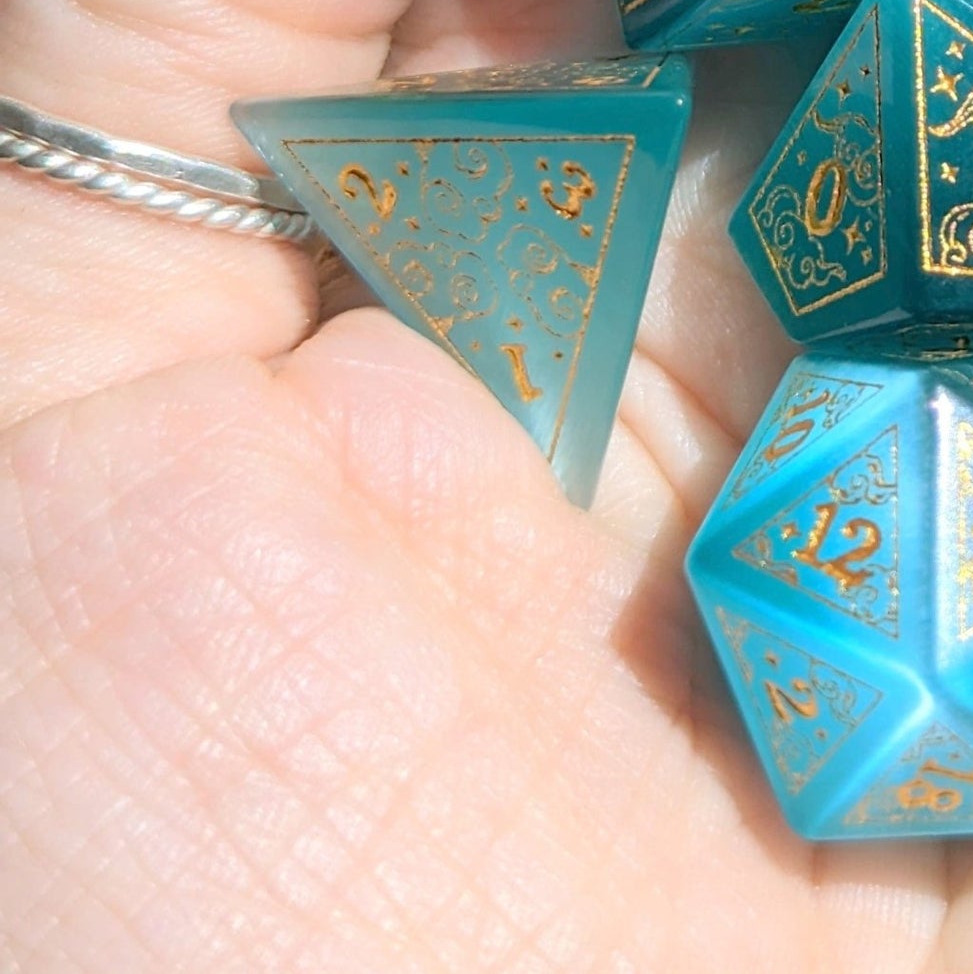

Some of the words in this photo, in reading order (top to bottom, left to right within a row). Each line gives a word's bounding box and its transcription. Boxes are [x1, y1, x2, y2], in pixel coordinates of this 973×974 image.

[338, 162, 397, 221] 2
[539, 159, 598, 221] 3
[805, 158, 846, 237] 0
[501, 343, 545, 403] 1
[764, 387, 831, 463] 10
[790, 501, 883, 593] 12
[762, 678, 819, 725] 2
